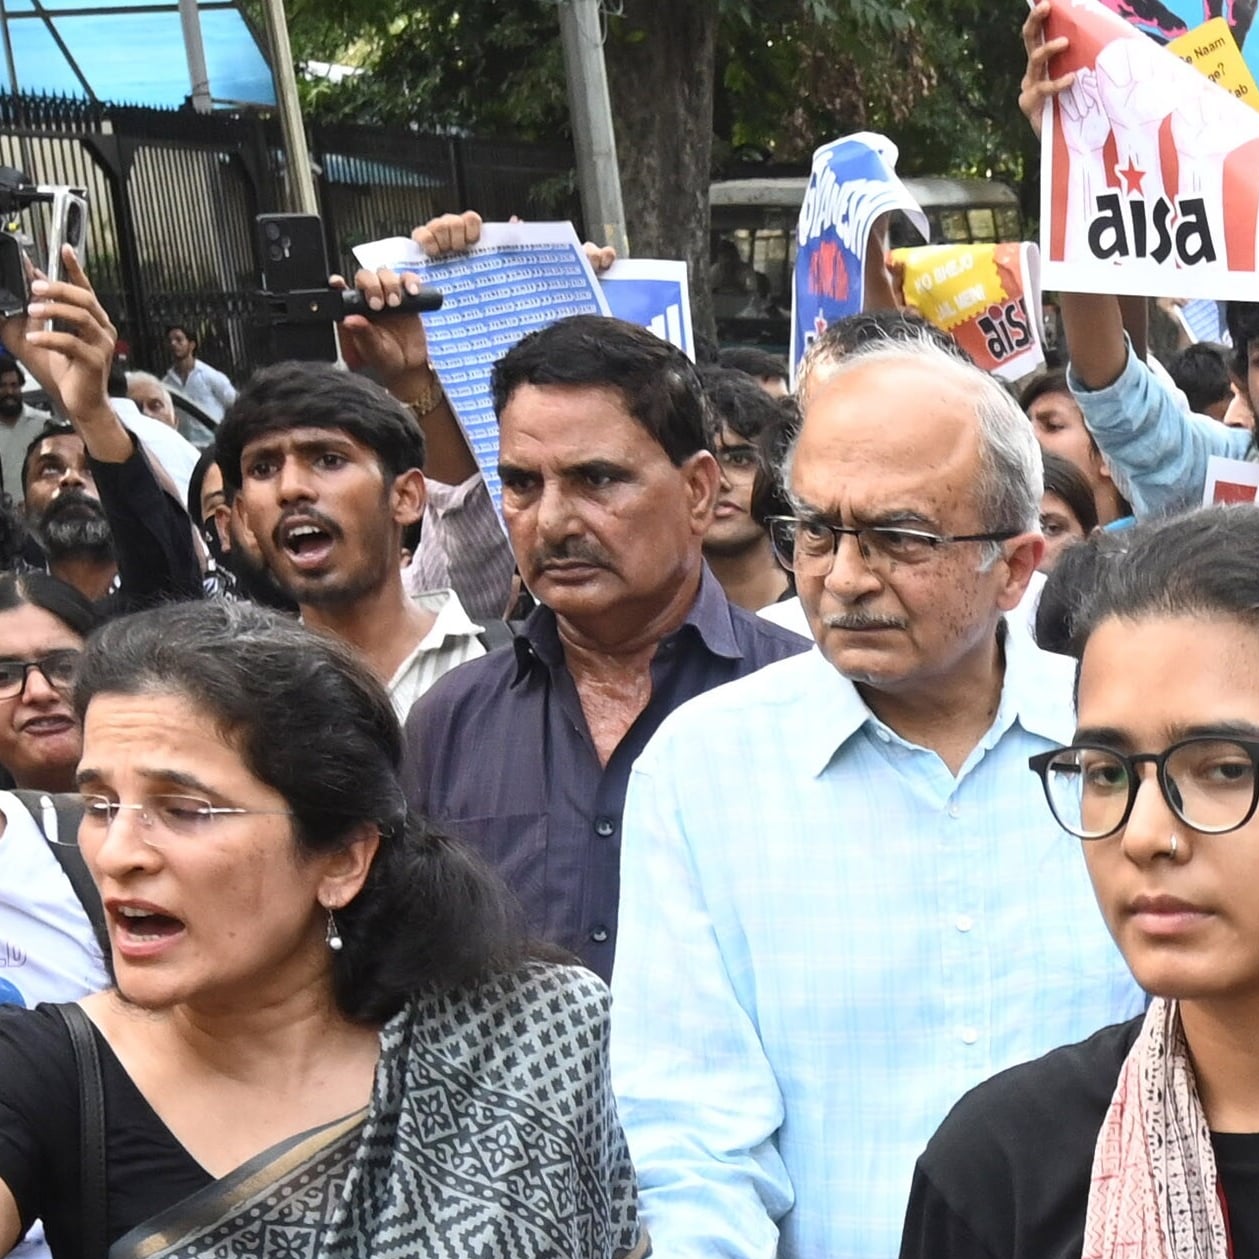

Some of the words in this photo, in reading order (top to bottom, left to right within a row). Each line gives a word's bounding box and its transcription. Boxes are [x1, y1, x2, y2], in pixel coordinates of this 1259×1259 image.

[1193, 37, 1226, 60] Naam
[1088, 160, 1217, 266] aisa
[977, 297, 1033, 360] ais
